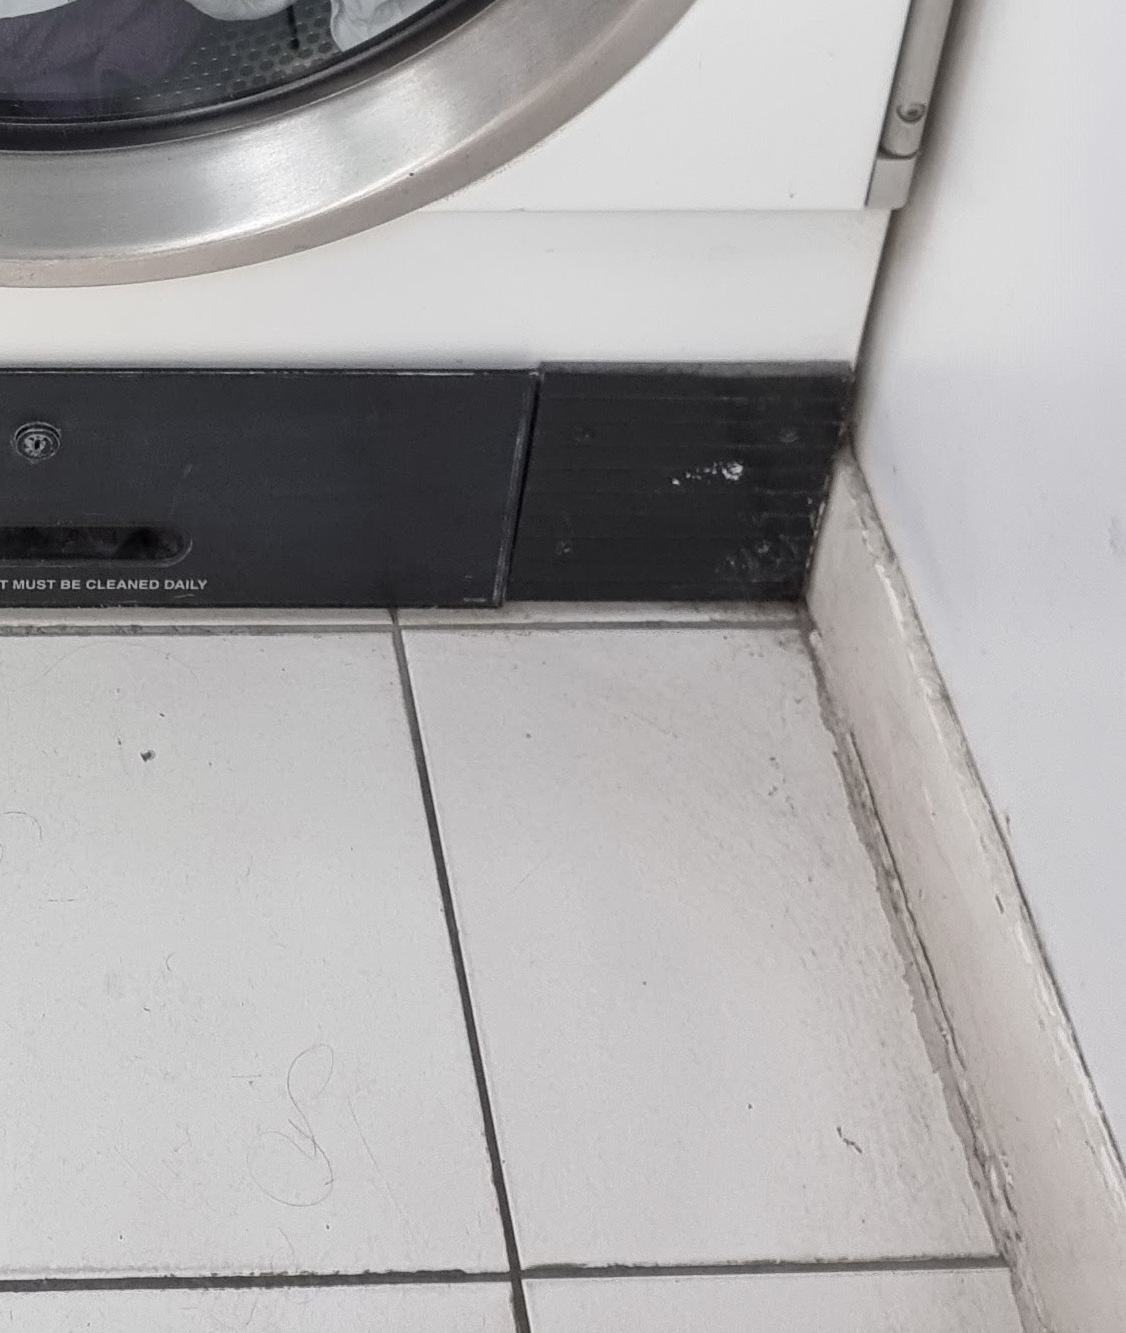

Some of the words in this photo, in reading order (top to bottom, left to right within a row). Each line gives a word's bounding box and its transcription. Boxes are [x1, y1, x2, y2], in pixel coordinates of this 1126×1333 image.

[12, 579, 57, 590] MUST
[60, 579, 81, 590] BE
[85, 579, 160, 590] CLEANED
[164, 579, 208, 590] DAILY
